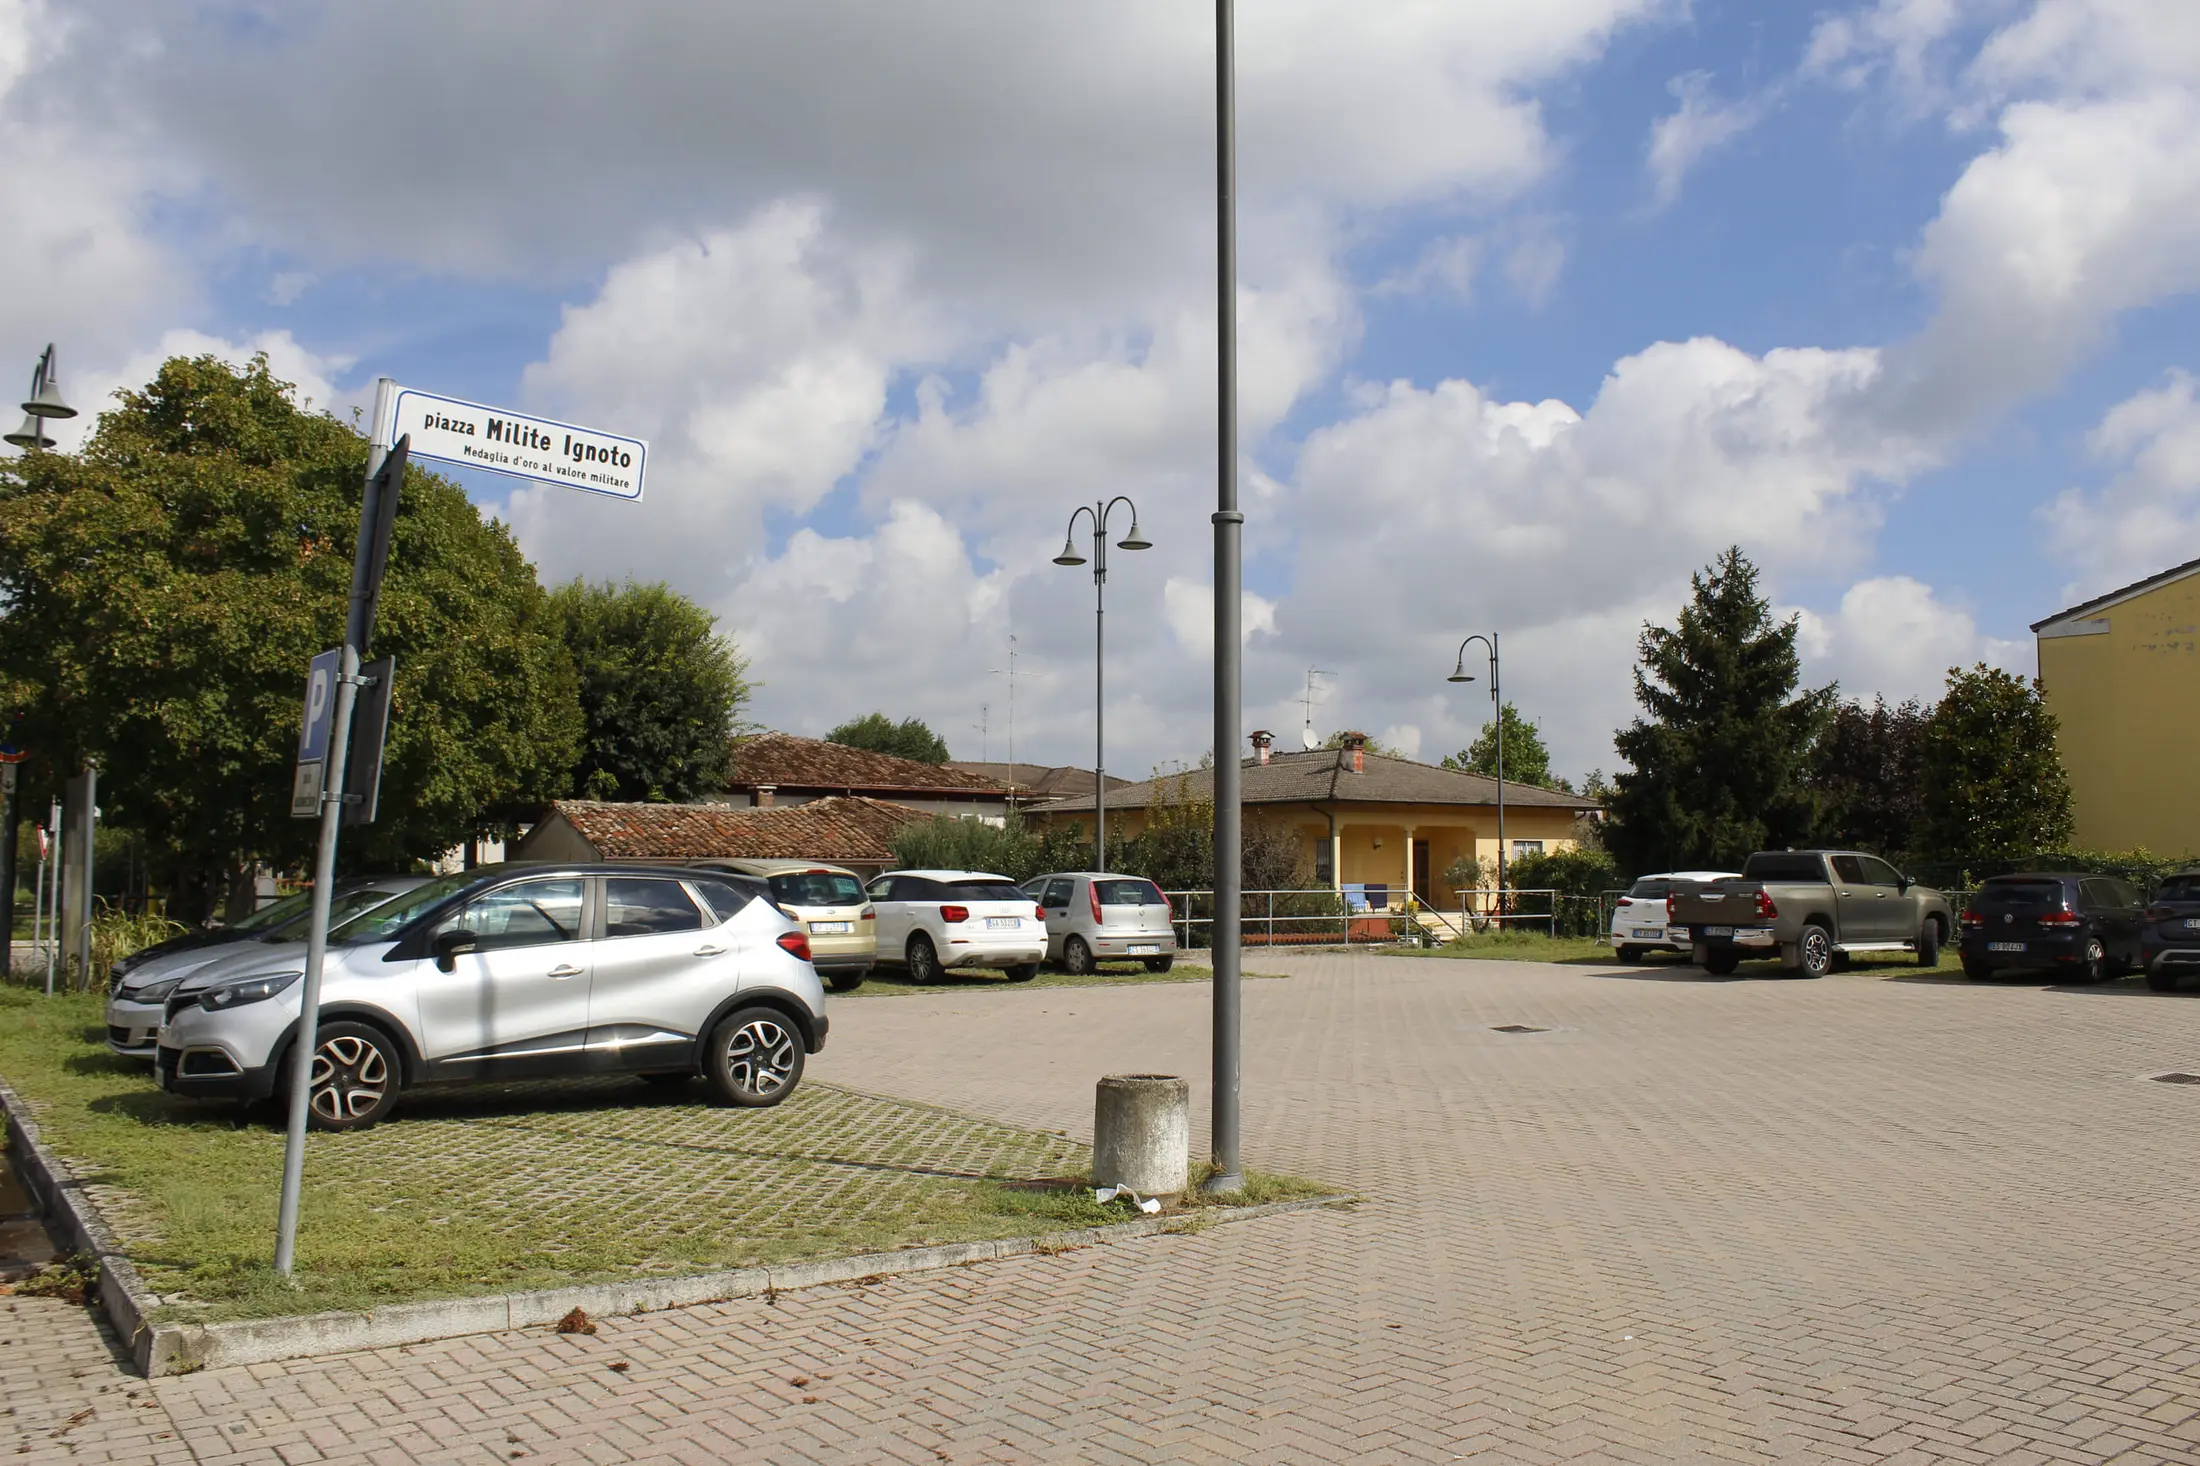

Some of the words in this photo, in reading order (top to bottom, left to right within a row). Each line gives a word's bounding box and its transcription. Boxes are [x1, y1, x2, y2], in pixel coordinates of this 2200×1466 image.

[424, 412, 475, 436] piazza
[486, 418, 552, 451] Milite
[563, 434, 632, 468] Ignoto
[463, 444, 509, 463] Medaglia
[512, 455, 539, 471] d'oro
[542, 462, 553, 473] al
[556, 466, 587, 480] valore
[590, 473, 630, 488] militare
[304, 668, 327, 749] P
